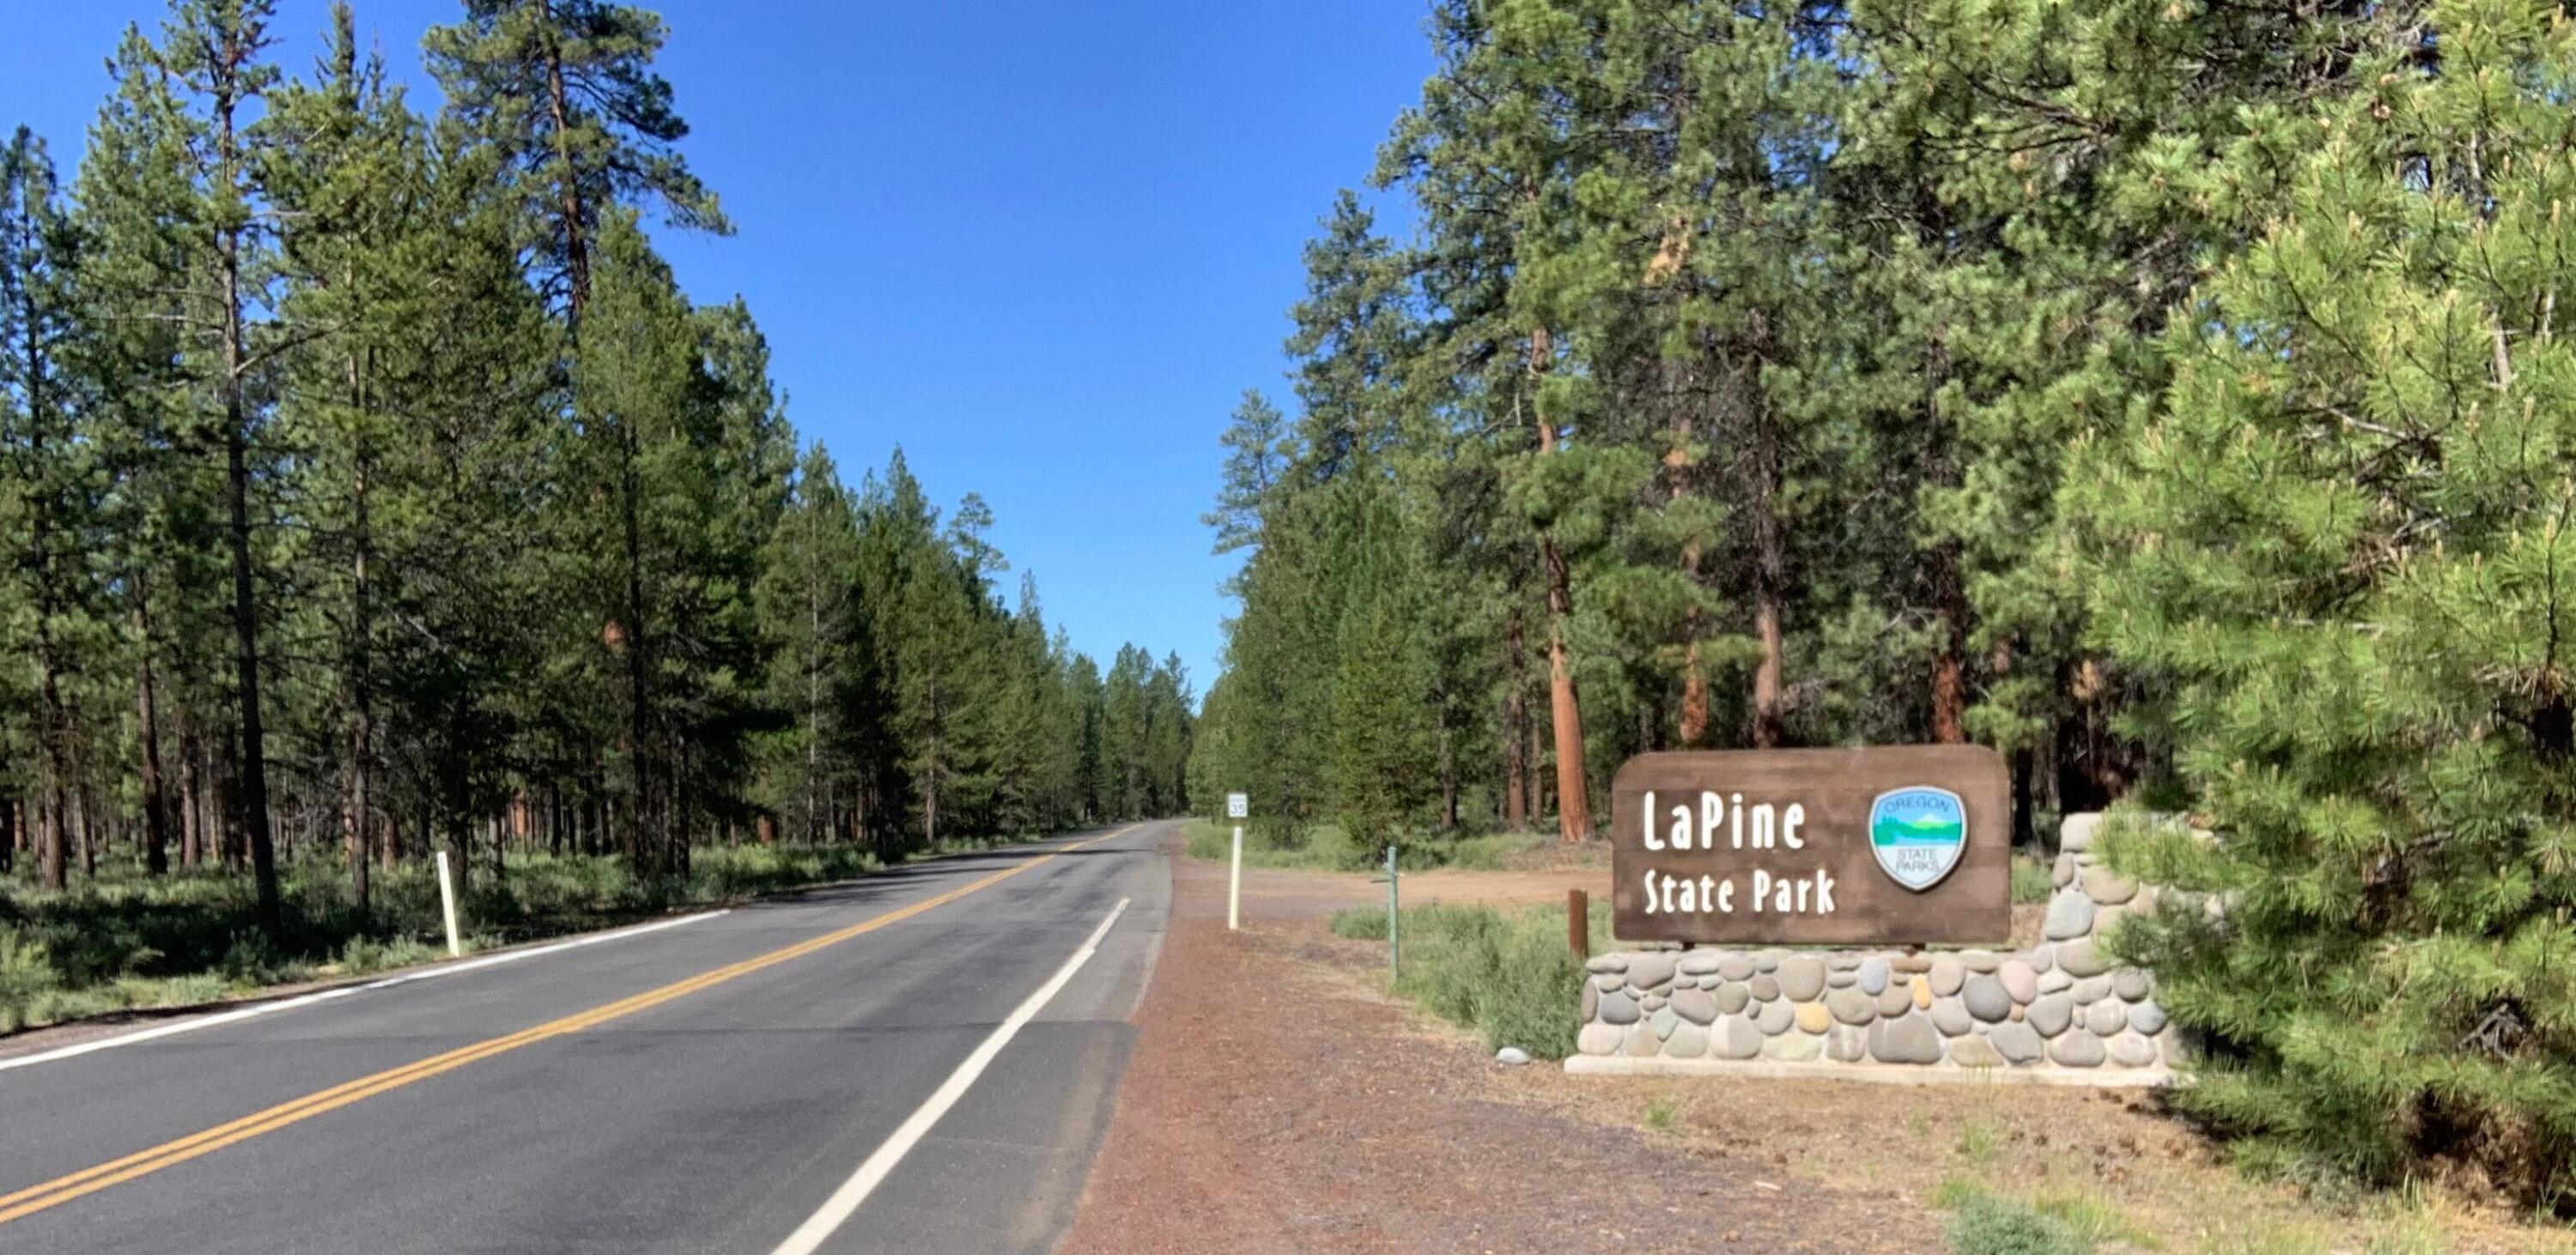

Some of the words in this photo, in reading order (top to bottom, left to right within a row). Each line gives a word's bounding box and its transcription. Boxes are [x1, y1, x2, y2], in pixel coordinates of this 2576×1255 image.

[1230, 804, 1246, 814] 35
[1884, 795, 1951, 814] OREGON
[1643, 791, 1805, 850] LaPine
[1897, 848, 1938, 860] STATE
[1896, 860, 1941, 872] PARKS
[1644, 868, 1735, 914] State
[1753, 868, 1836, 914] Park
